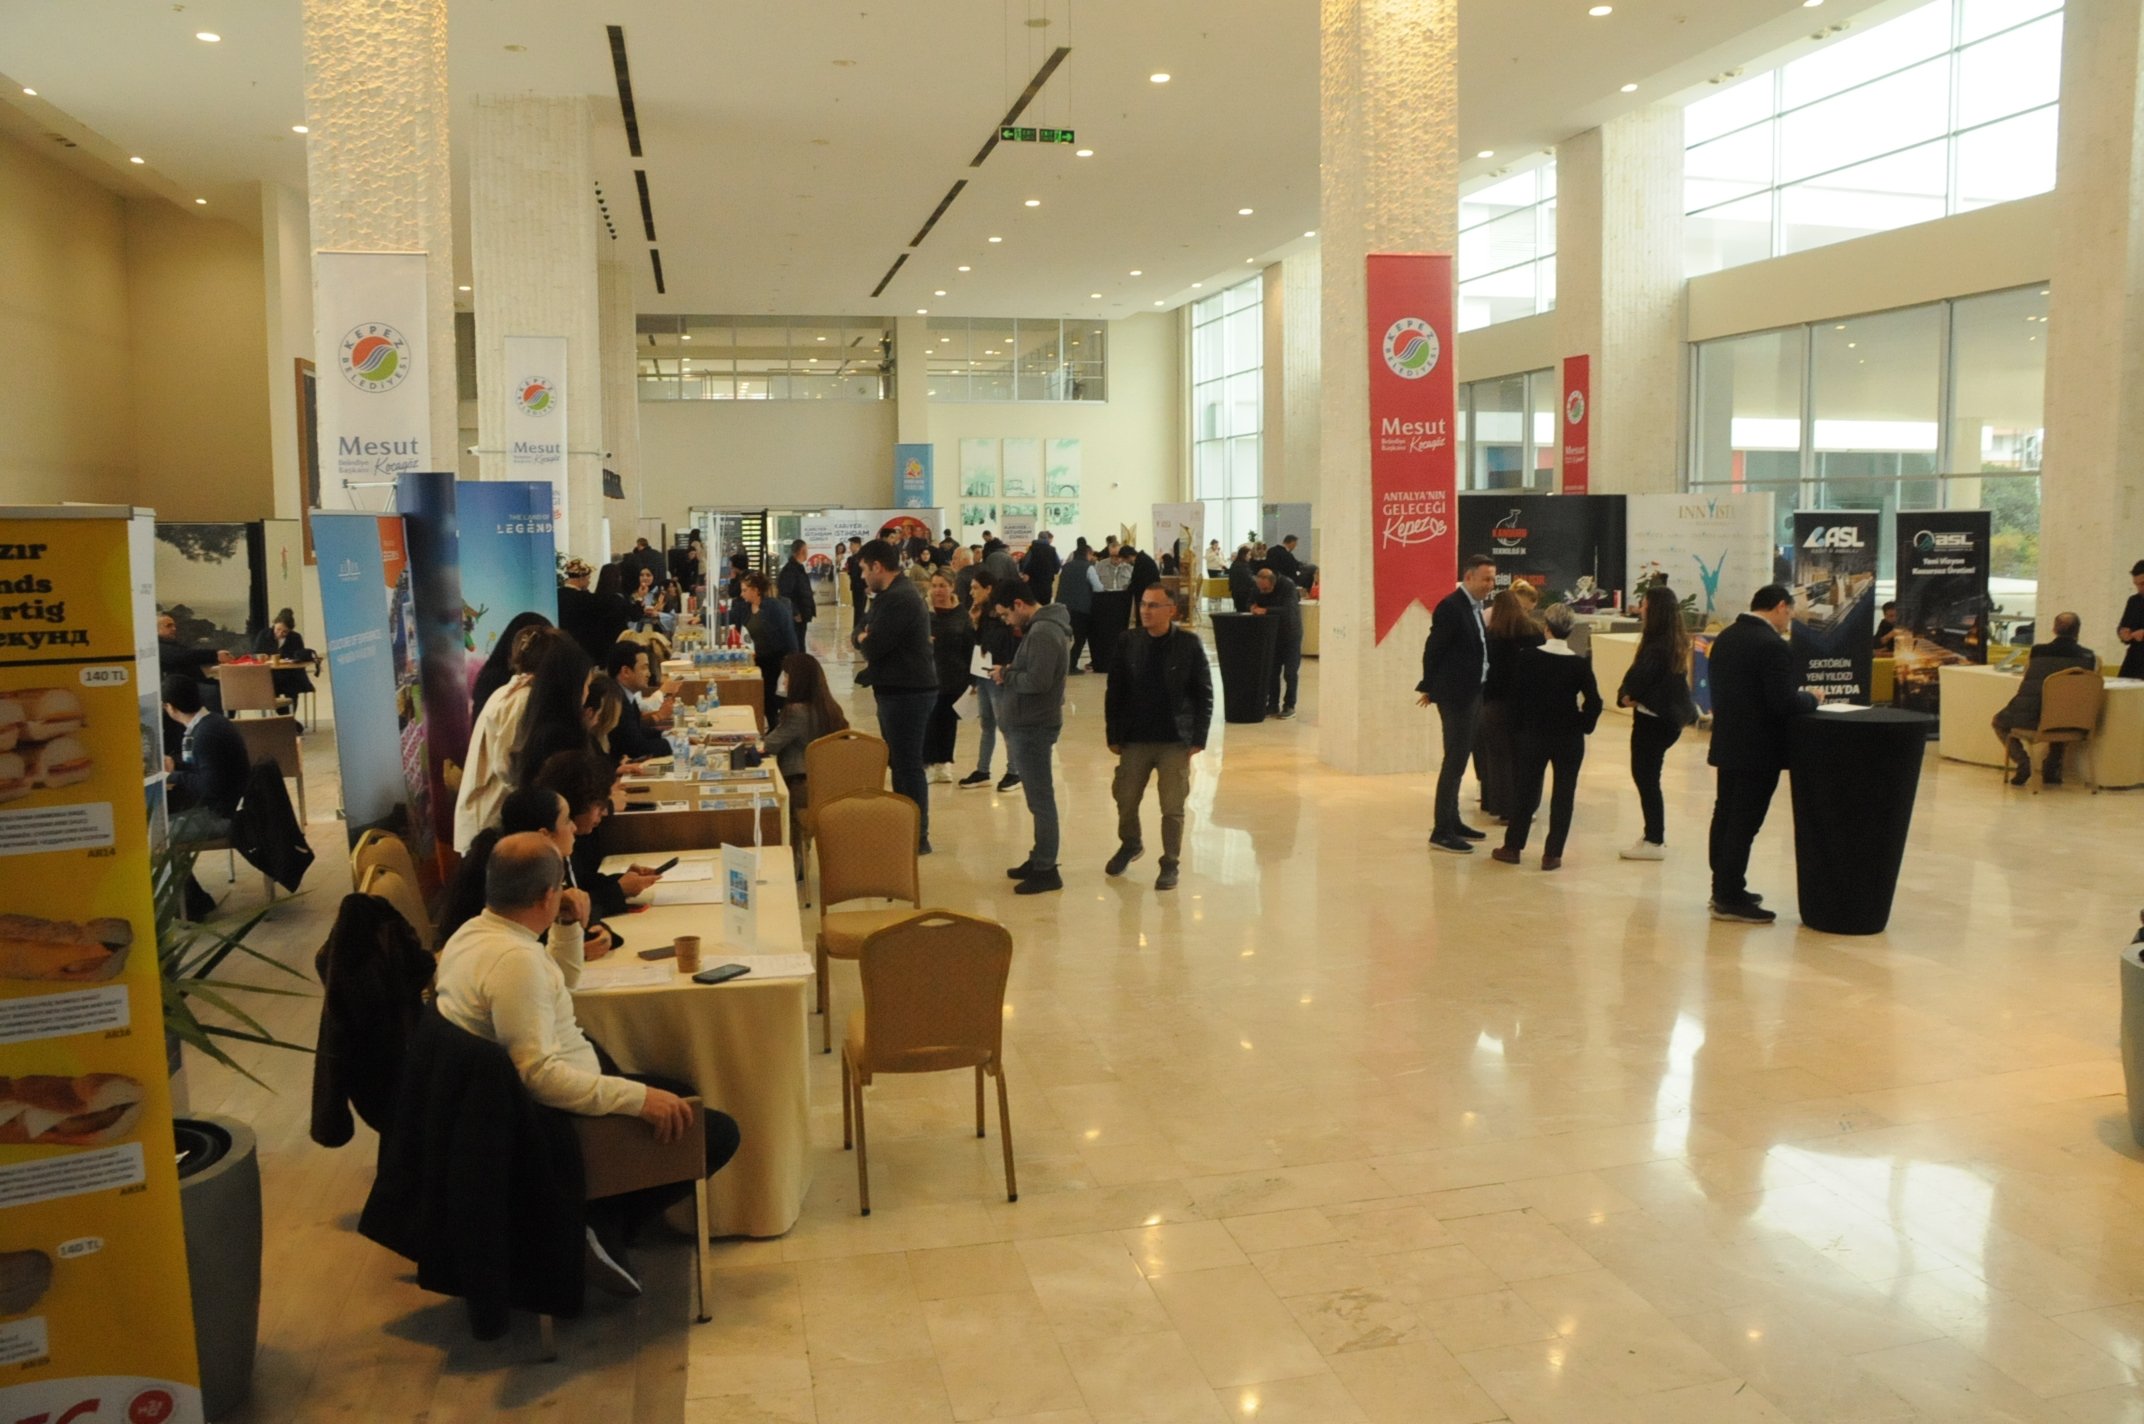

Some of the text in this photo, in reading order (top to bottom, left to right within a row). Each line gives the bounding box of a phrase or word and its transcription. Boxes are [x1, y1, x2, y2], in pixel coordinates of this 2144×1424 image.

[1381, 417, 1446, 436] Mesut
[338, 436, 419, 456] Mesut
[513, 441, 561, 454] Mesut
[1808, 657, 1852, 669] SEKTÖRÜN
[85, 670, 126, 682] 140 TL
[1806, 671, 1825, 682] YENİ
